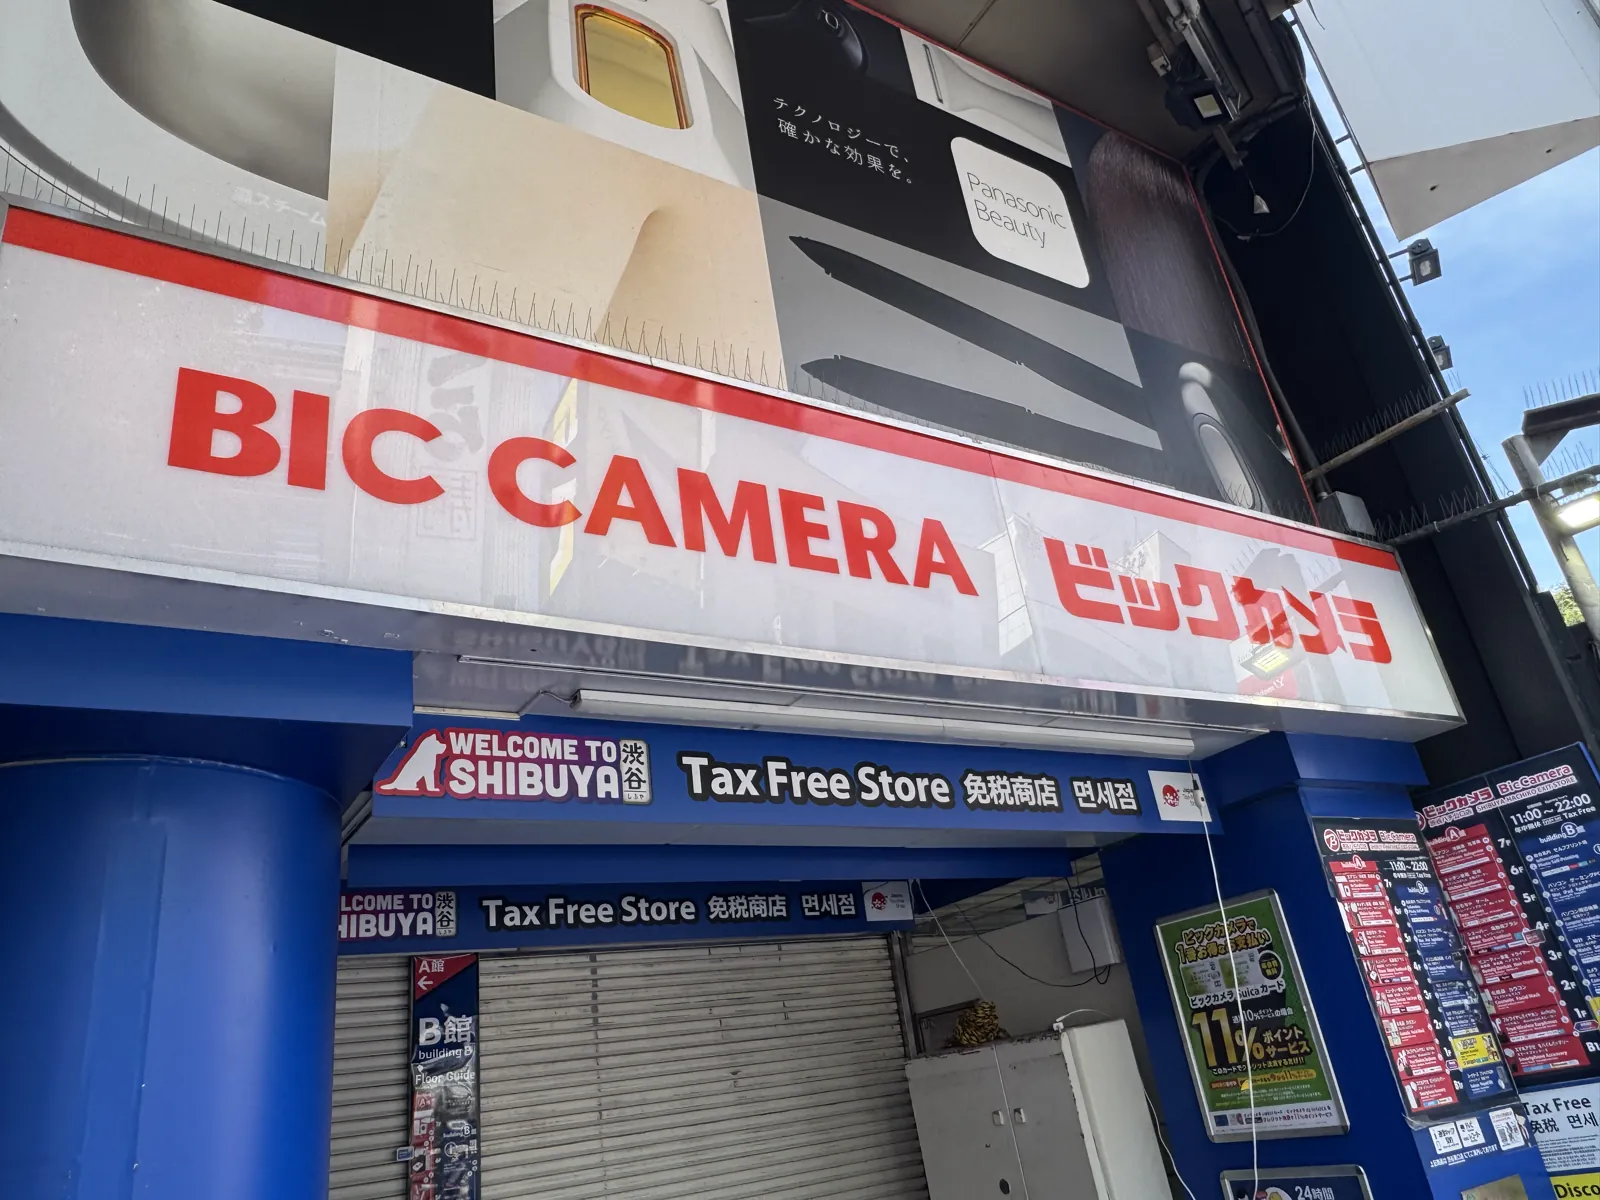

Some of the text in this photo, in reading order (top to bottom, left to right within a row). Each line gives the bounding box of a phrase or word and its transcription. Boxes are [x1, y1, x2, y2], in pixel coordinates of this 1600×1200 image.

[774, 97, 909, 163] テクノロジーで、
[777, 117, 912, 184] 確かな効果を。
[967, 172, 1067, 229] Panasonic
[974, 199, 1046, 248] Beauty
[168, 368, 446, 505] BIC
[488, 437, 979, 598] CAMERA
[1043, 537, 1393, 665] ビックカメラ
[449, 732, 617, 763] WELCOME TO
[621, 743, 648, 789] 渋谷
[449, 759, 619, 799] SHIBUYA
[681, 756, 951, 803] Tax Free Store
[963, 773, 1059, 808] 免税商店
[1497, 764, 1574, 796] BicCamera
[1072, 779, 1138, 811] 면세점
[1423, 787, 1494, 818] ビックカメラ
[1510, 808, 1542, 826] 11:00
[1554, 794, 1591, 814] 22:00
[1563, 806, 1597, 820] Tax Free
[1498, 838, 1511, 848] 7F
[1539, 832, 1567, 843] building
[1510, 865, 1524, 875] 6F
[409, 894, 433, 909] TO
[707, 895, 787, 919] 免税商店
[801, 893, 856, 916] 면세점
[1523, 892, 1536, 903] 5F
[436, 894, 455, 928] 渋谷
[482, 896, 696, 927] Tax Free Store
[1183, 918, 1257, 945] ビックカメラで
[1536, 921, 1550, 931] 4F
[419, 960, 445, 973] A館
[1547, 950, 1562, 961] 3F
[1560, 980, 1576, 991] 2F
[1574, 1008, 1587, 1018] 1F
[419, 1014, 473, 1046] B館
[1263, 1026, 1304, 1044] ポイント
[418, 1045, 473, 1060] building B
[1265, 1040, 1312, 1059] サービス
[415, 1071, 476, 1085] Floor Guide
[1523, 1097, 1592, 1116] Tax Free
[1530, 1117, 1560, 1134] 免税
[1567, 1112, 1600, 1129] 면세
[1294, 1185, 1335, 1200] 24時間
